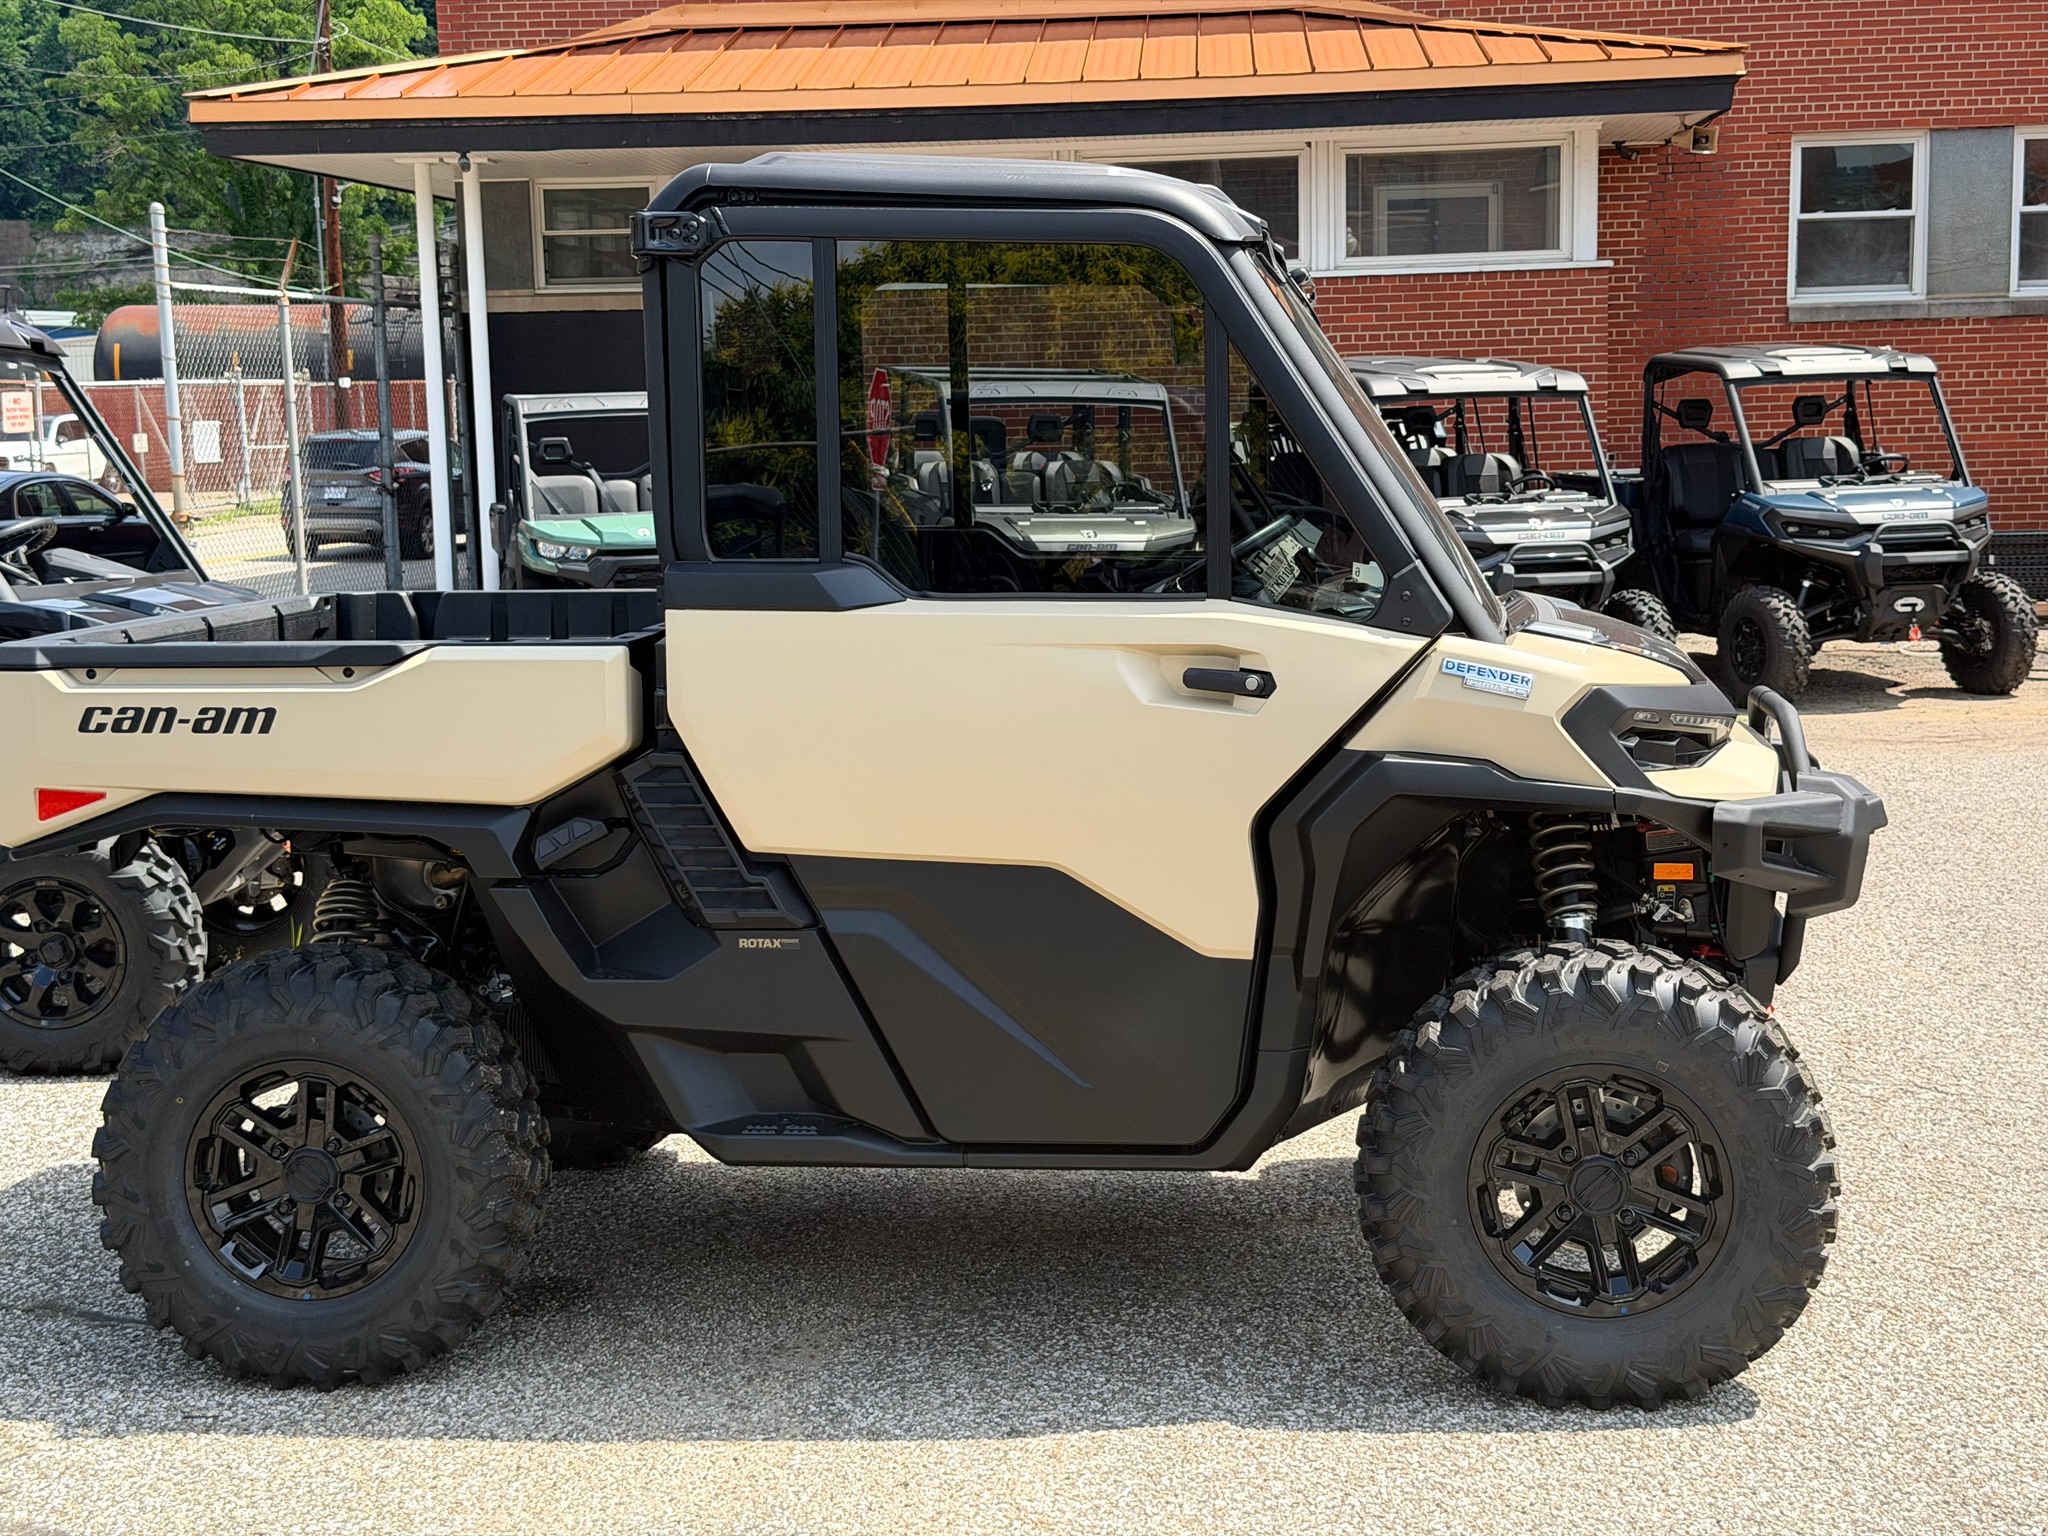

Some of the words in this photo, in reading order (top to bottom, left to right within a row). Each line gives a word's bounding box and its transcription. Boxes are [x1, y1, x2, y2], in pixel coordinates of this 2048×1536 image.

[1881, 511, 1929, 520] can-am
[1517, 531, 1565, 540] can-am
[1445, 660, 1531, 686] DEFENDER
[78, 706, 277, 734] can-am
[739, 938, 781, 948] ROTAX
